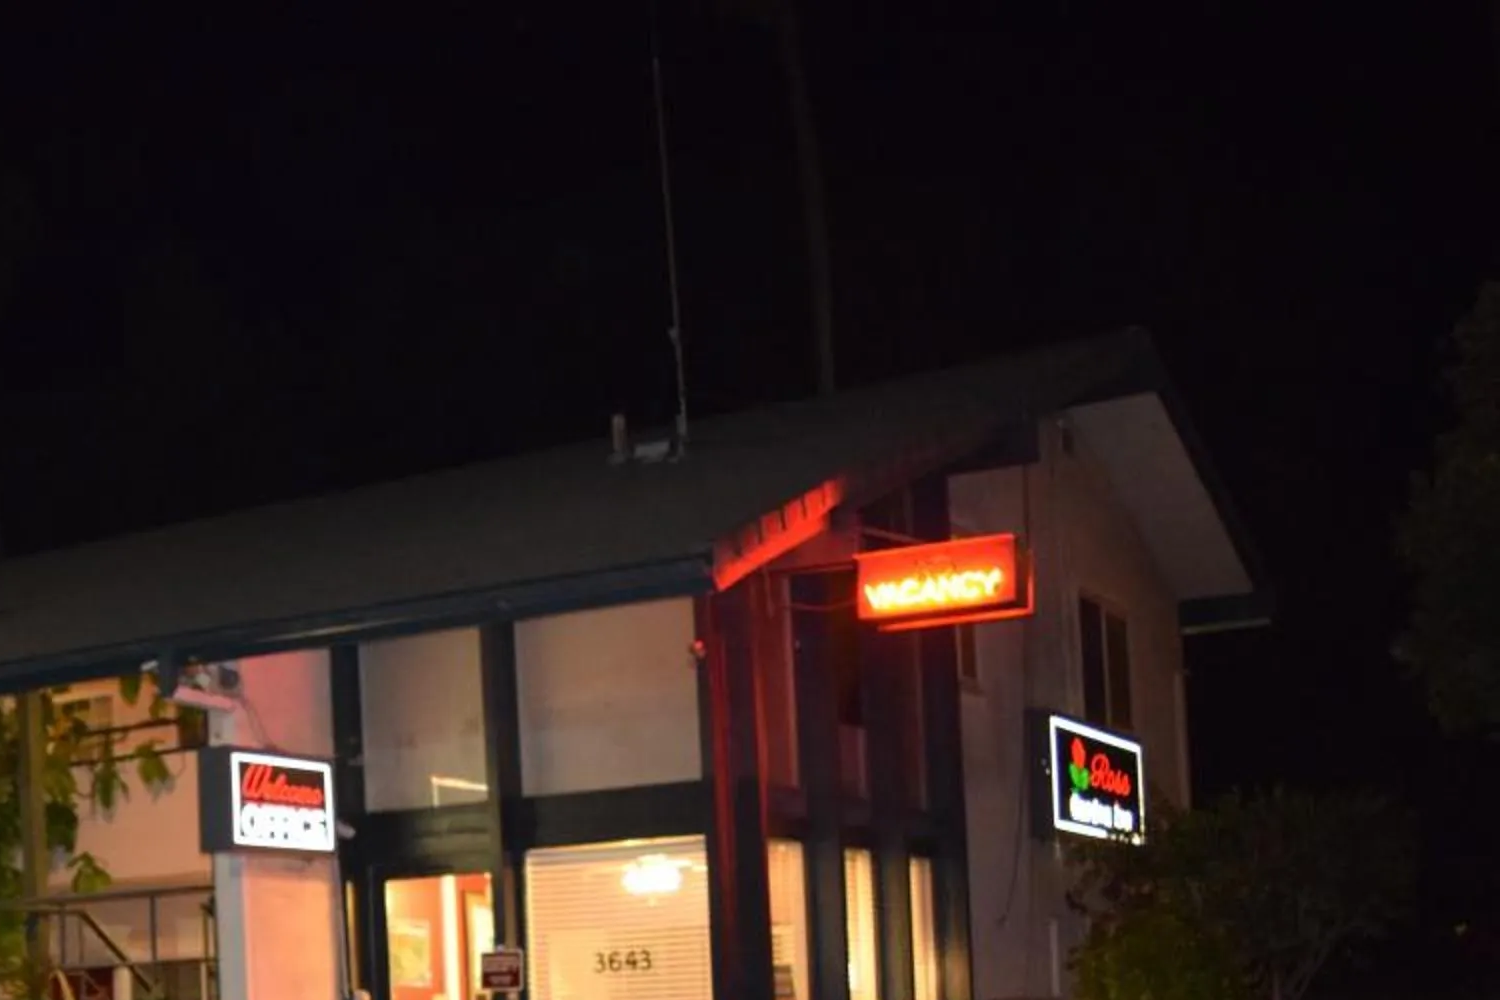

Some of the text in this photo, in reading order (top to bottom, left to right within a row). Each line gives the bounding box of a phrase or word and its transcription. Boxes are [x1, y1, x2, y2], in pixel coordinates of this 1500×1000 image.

[864, 565, 1002, 610] VACANCY
[241, 802, 328, 843] OFFICE
[595, 950, 652, 974] 3643
